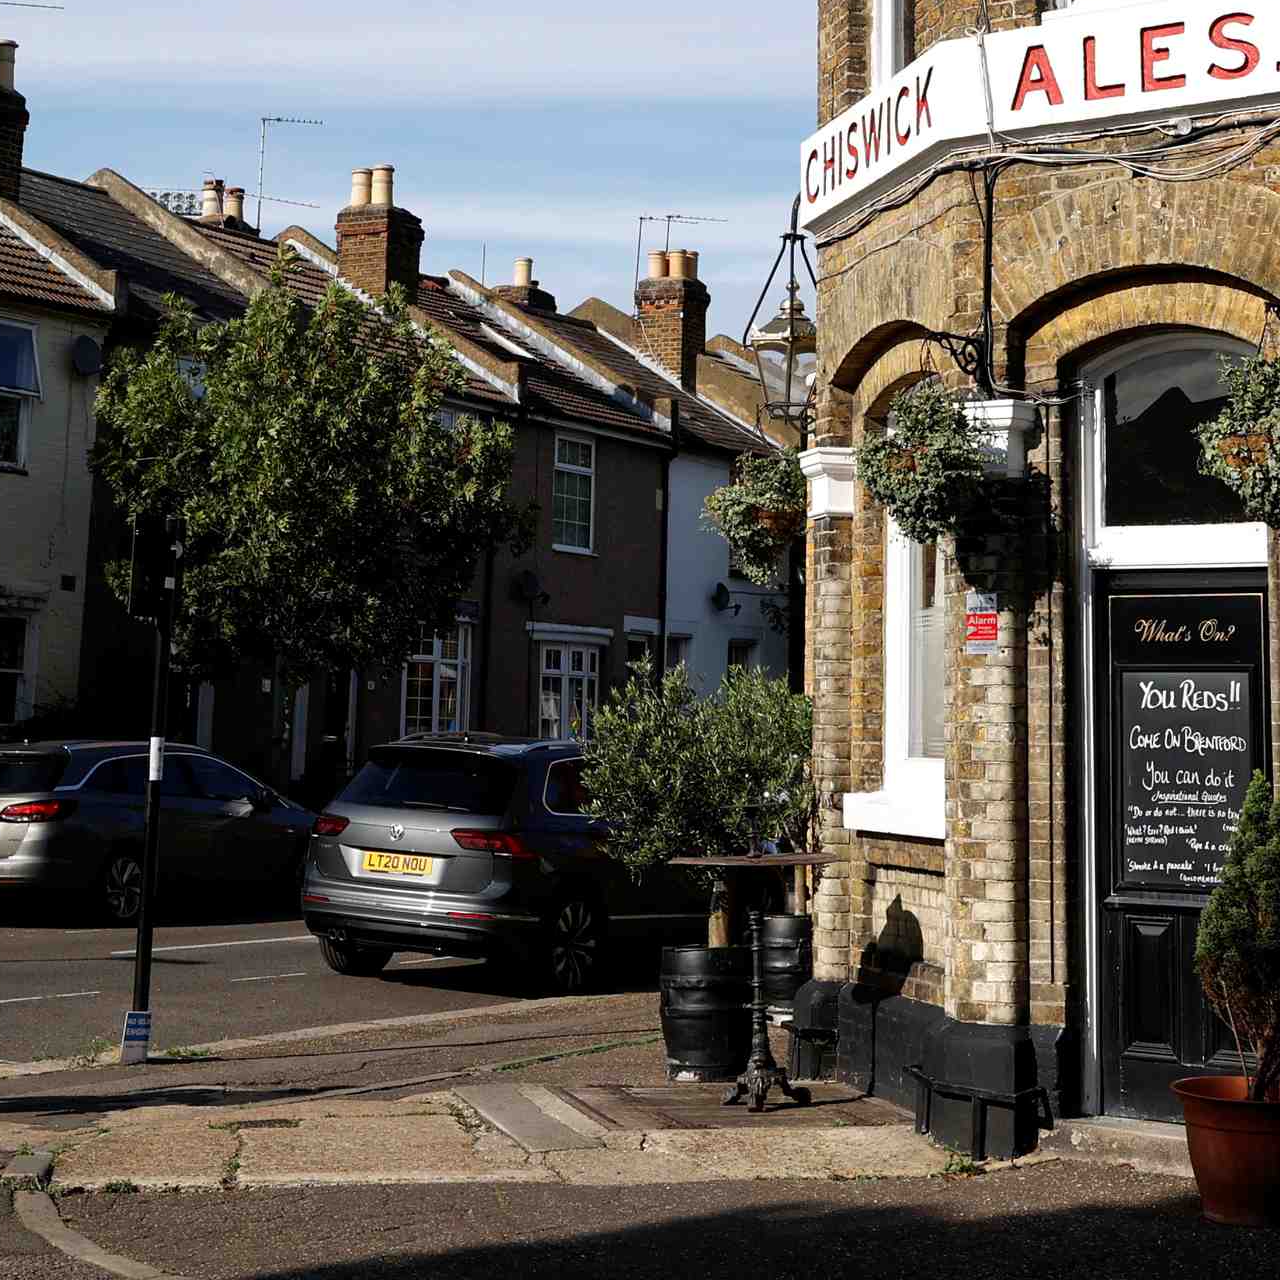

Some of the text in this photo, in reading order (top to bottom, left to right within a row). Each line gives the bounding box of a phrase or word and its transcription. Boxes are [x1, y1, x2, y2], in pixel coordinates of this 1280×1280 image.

[805, 65, 934, 205] CHISWICK
[967, 614, 997, 625] Alarm
[1134, 618, 1236, 642] What's On?
[1129, 724, 1161, 749] COME
[1181, 726, 1247, 756] BRENTFORD
[1142, 760, 1235, 790] You can do it
[368, 853, 400, 869] LT20
